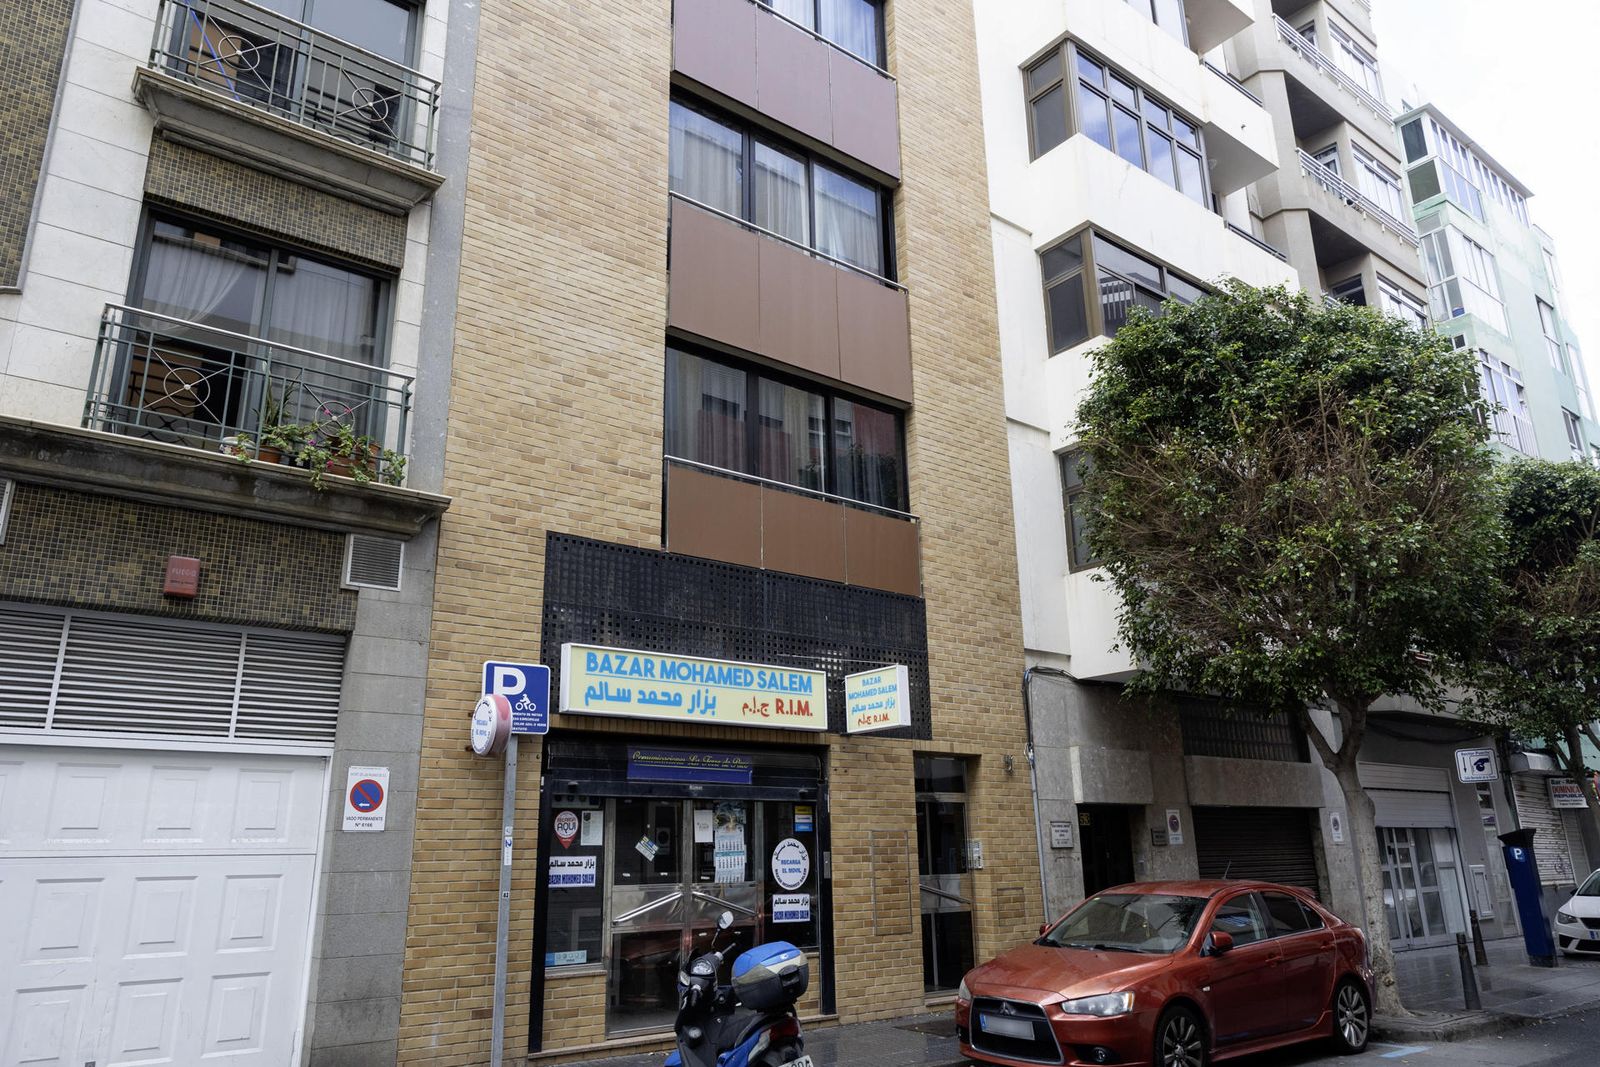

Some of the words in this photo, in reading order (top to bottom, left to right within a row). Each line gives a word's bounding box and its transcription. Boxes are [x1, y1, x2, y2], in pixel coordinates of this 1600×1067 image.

[171, 567, 197, 577] FUEGO
[586, 652, 655, 679] BAZAR
[660, 660, 754, 687] MOHAMED
[757, 672, 813, 694] SALEM
[493, 666, 526, 696] P
[862, 676, 882, 687] BAZAR
[585, 681, 632, 706] سالم
[848, 687, 877, 699] MOHAMED
[878, 684, 897, 695] SALEM
[637, 689, 682, 707] محمد
[686, 688, 716, 716] بزار
[775, 698, 813, 716] R.I.M.
[852, 704, 867, 715] سالم
[868, 700, 883, 711] محمد
[1513, 848, 1523, 860] P
[584, 859, 595, 869] بزار
[562, 874, 581, 884] MOHAMED
[582, 873, 595, 884] SALEM
[774, 897, 787, 907] سالم
[800, 896, 809, 906] بزار
[784, 911, 799, 920] MOHAMED
[799, 910, 809, 919] SALEM
